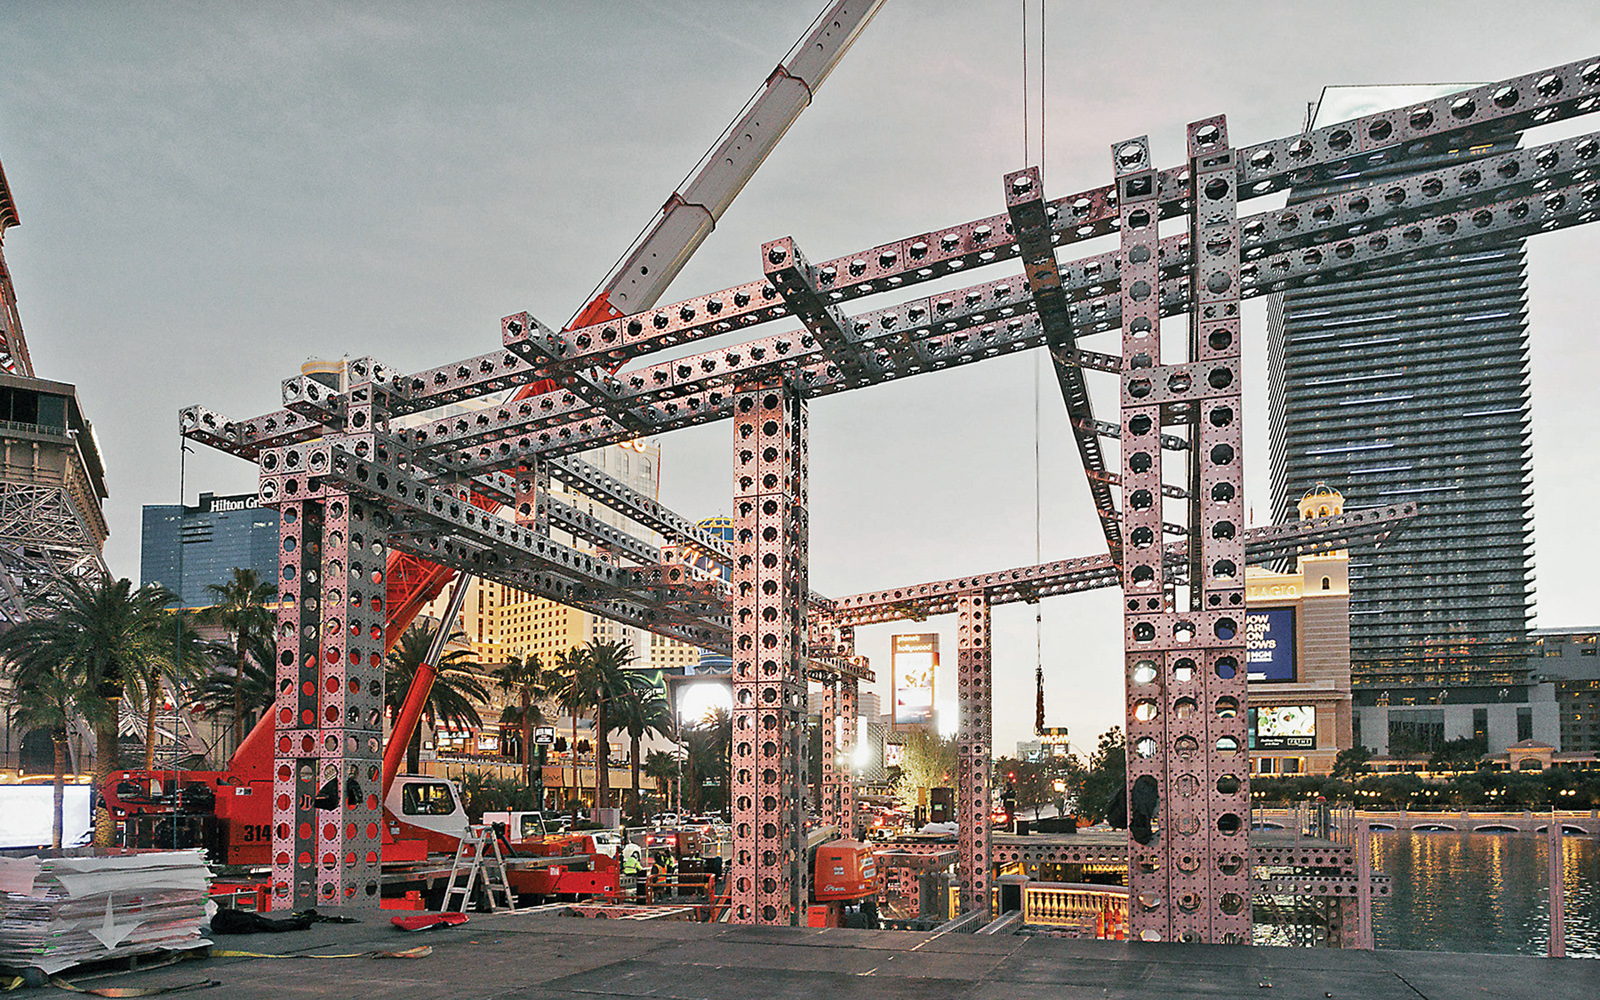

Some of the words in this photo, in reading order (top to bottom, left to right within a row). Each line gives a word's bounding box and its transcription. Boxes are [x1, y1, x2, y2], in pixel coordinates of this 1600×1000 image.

[210, 500, 245, 512] Hilton
[245, 497, 263, 509] Gr
[1246, 585, 1297, 597] LAGIO
[1246, 623, 1271, 632] ARN
[897, 635, 920, 644] planet
[897, 643, 933, 653] hollywood
[1040, 734, 1069, 745] MGM
